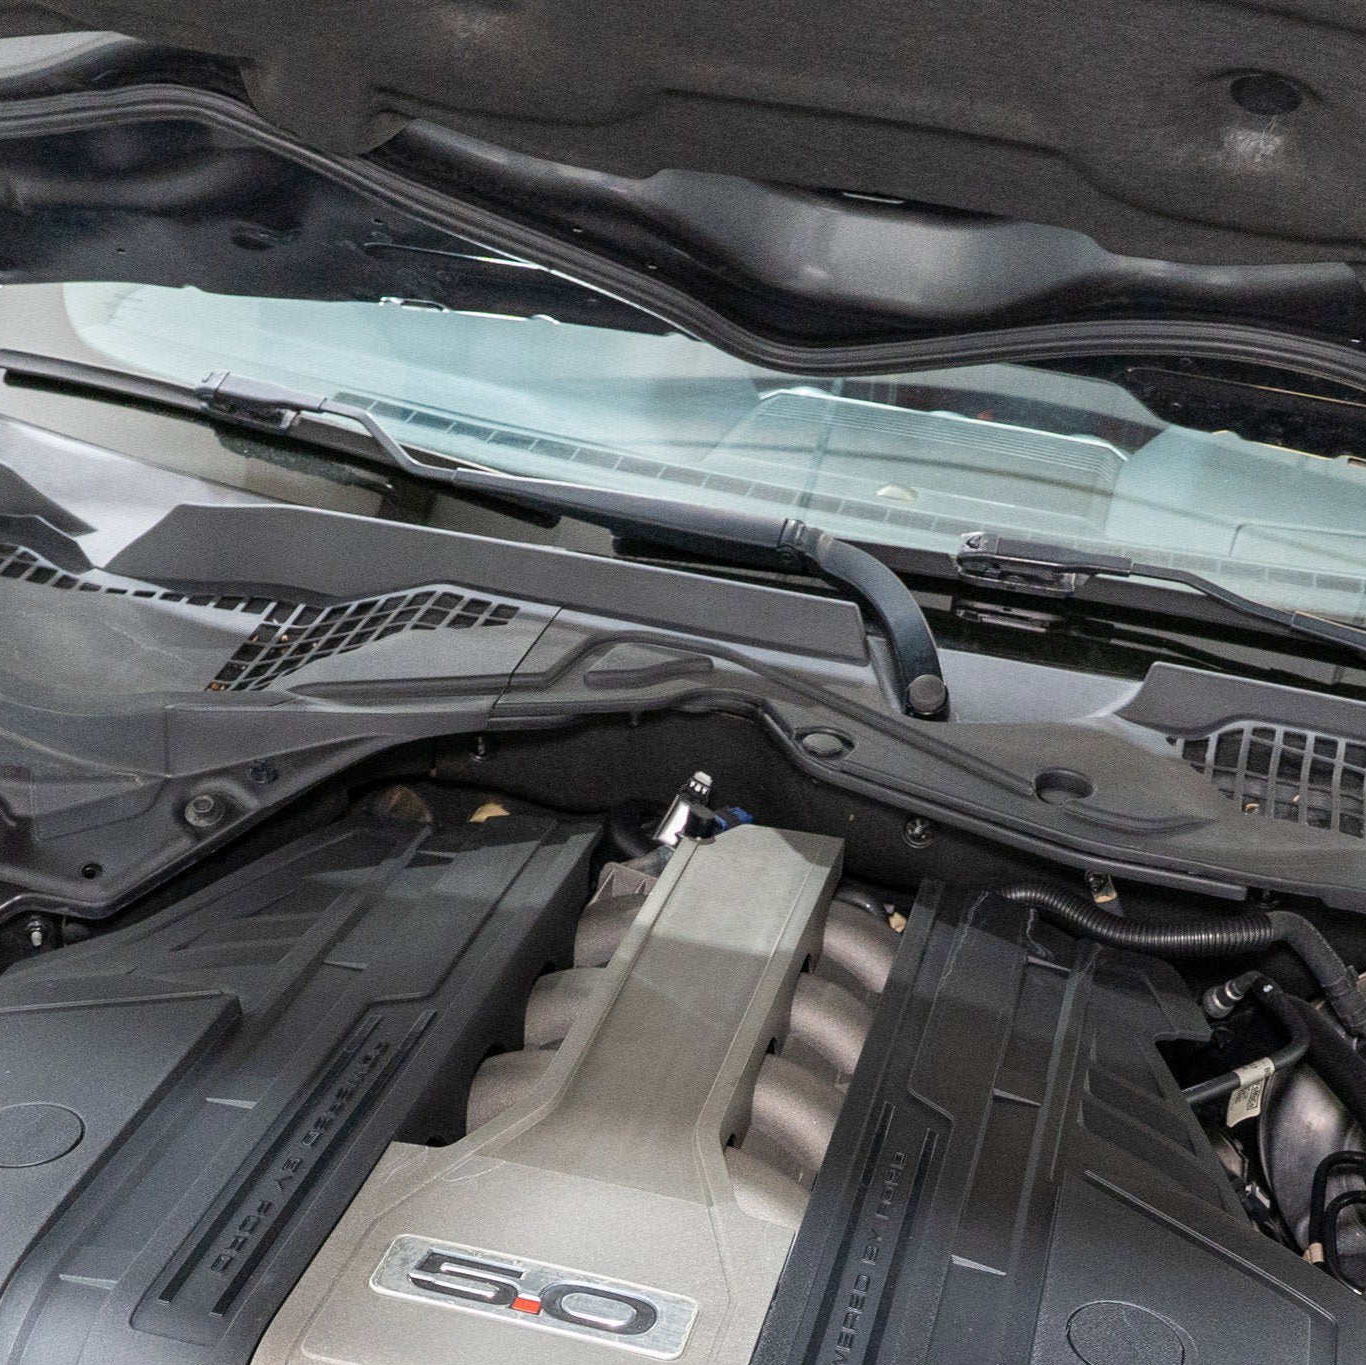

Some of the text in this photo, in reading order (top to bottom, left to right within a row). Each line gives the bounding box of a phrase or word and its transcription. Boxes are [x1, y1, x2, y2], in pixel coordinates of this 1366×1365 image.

[860, 1227, 883, 1266] BY
[875, 1151, 905, 1221] FORD
[407, 1250, 658, 1336] 5.0
